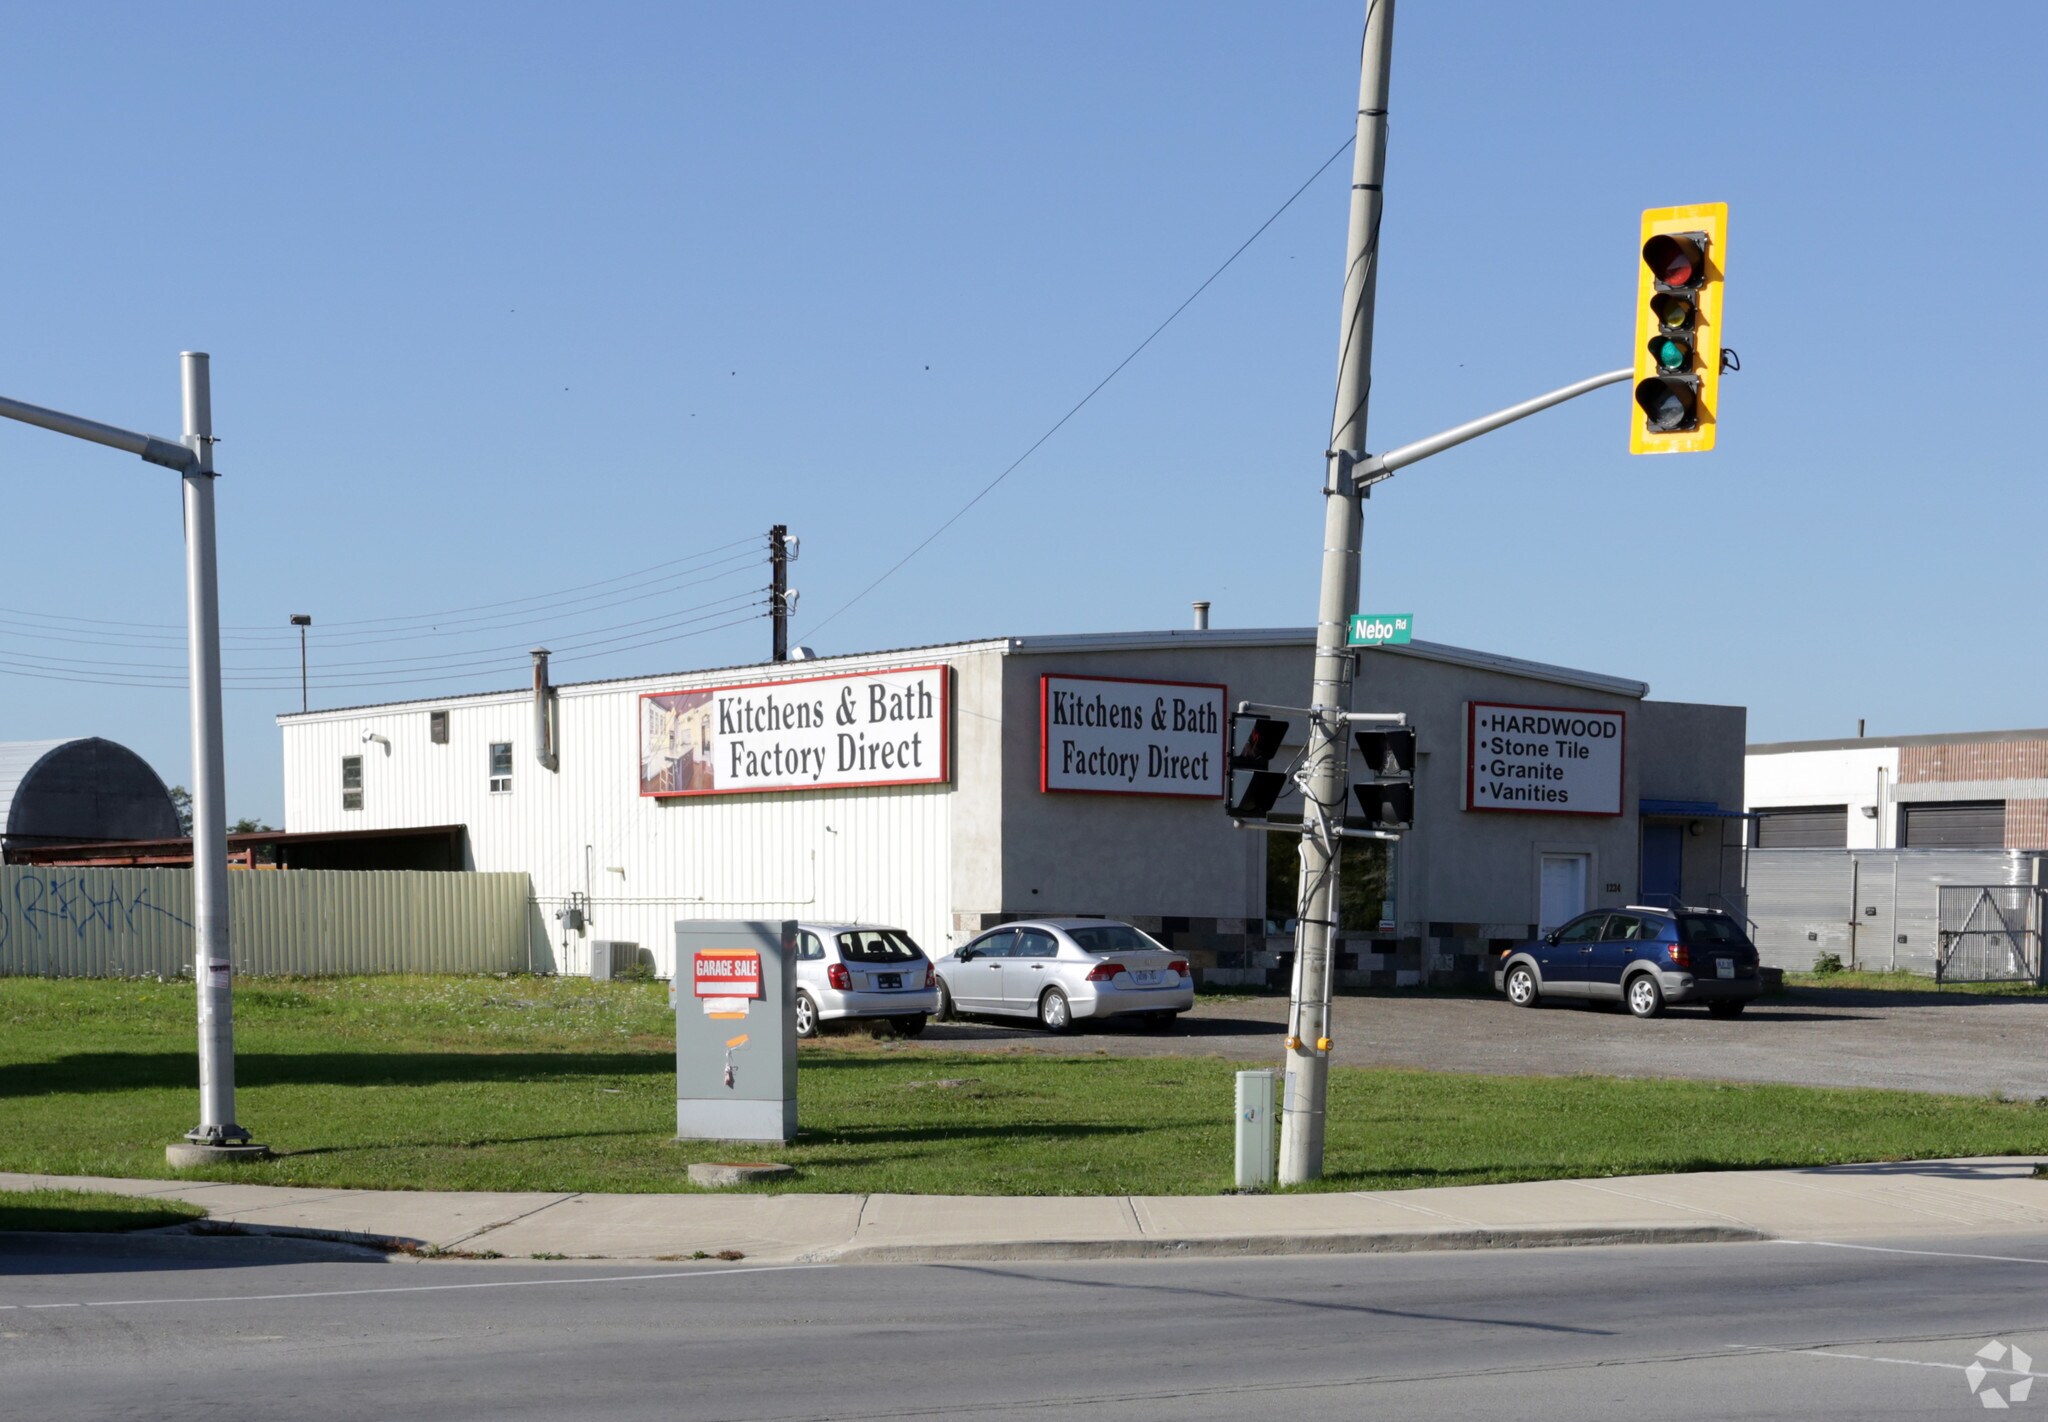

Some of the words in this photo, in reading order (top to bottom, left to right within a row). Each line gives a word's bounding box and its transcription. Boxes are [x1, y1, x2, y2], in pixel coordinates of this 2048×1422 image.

[1355, 619, 1393, 639] Nebo
[1395, 618, 1407, 630] Rd
[719, 694, 824, 735] Kitchens
[835, 686, 857, 726] &
[868, 679, 933, 724] Bath
[1053, 691, 1143, 730] Kitchens
[1152, 697, 1167, 731] &
[1172, 698, 1218, 734] Bath
[1491, 714, 1617, 739] HARDWOOD
[730, 741, 826, 781] Factory
[837, 731, 922, 772] Direct
[1490, 737, 1549, 757] Stone
[1555, 740, 1590, 759] Tile
[1062, 740, 1139, 783] Factory
[1148, 744, 1209, 781] Direct
[1490, 759, 1564, 780] Granite
[1489, 781, 1569, 803] Vanities
[696, 960, 733, 976] GARAGE
[734, 960, 757, 976] SALE
